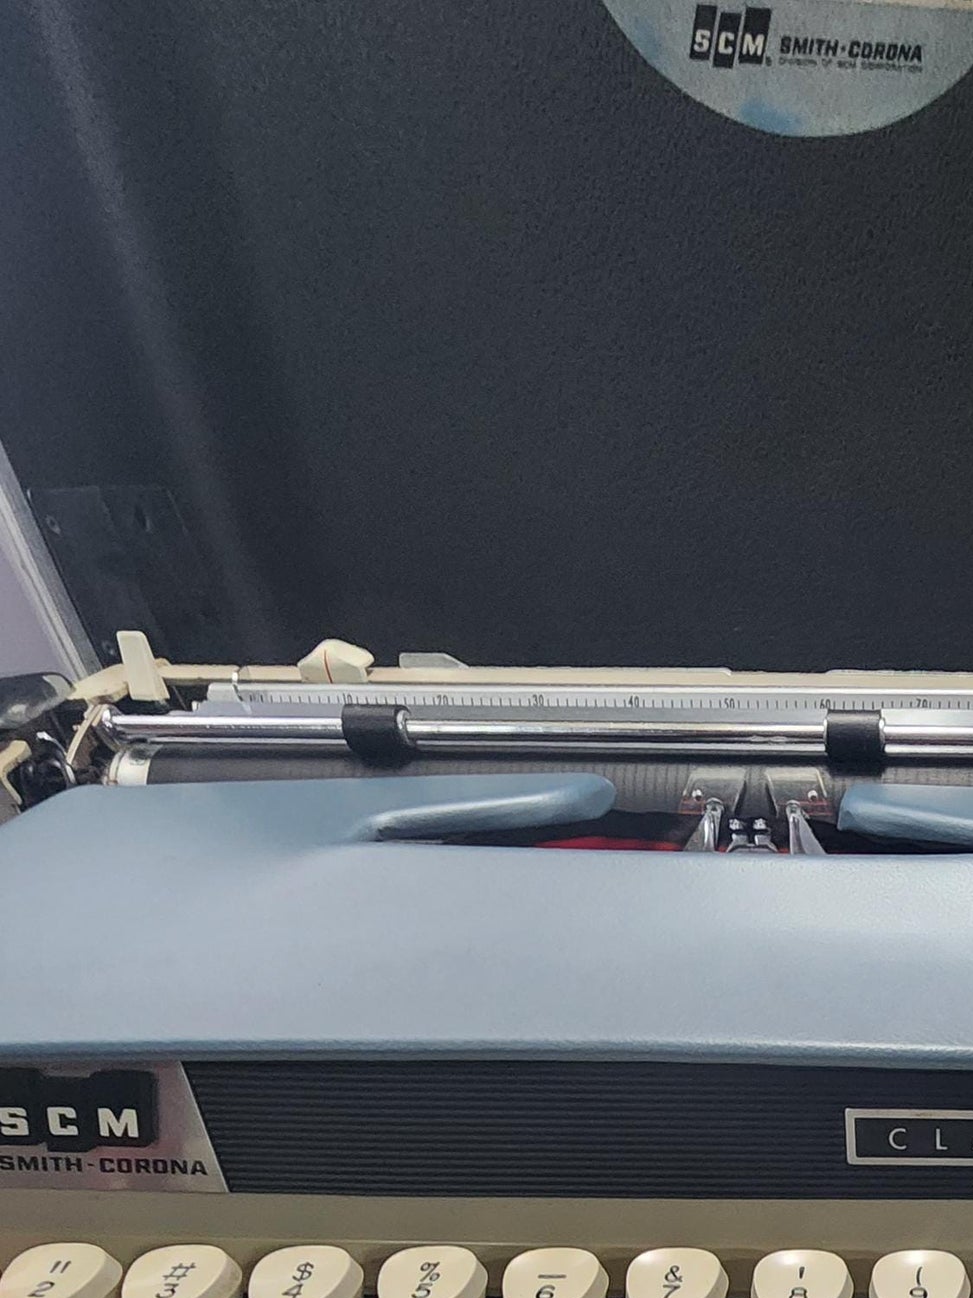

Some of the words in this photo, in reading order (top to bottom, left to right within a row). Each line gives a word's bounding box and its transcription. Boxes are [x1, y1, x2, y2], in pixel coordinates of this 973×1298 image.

[693, 29, 765, 56] SCM
[533, 694, 544, 706] 30
[628, 695, 640, 708] 40
[0, 1106, 140, 1139] SCM
[162, 1262, 197, 1281] #
[292, 1261, 315, 1282] $
[419, 1261, 441, 1282] %
[664, 1265, 683, 1283] &
[27, 1280, 56, 1298] 2
